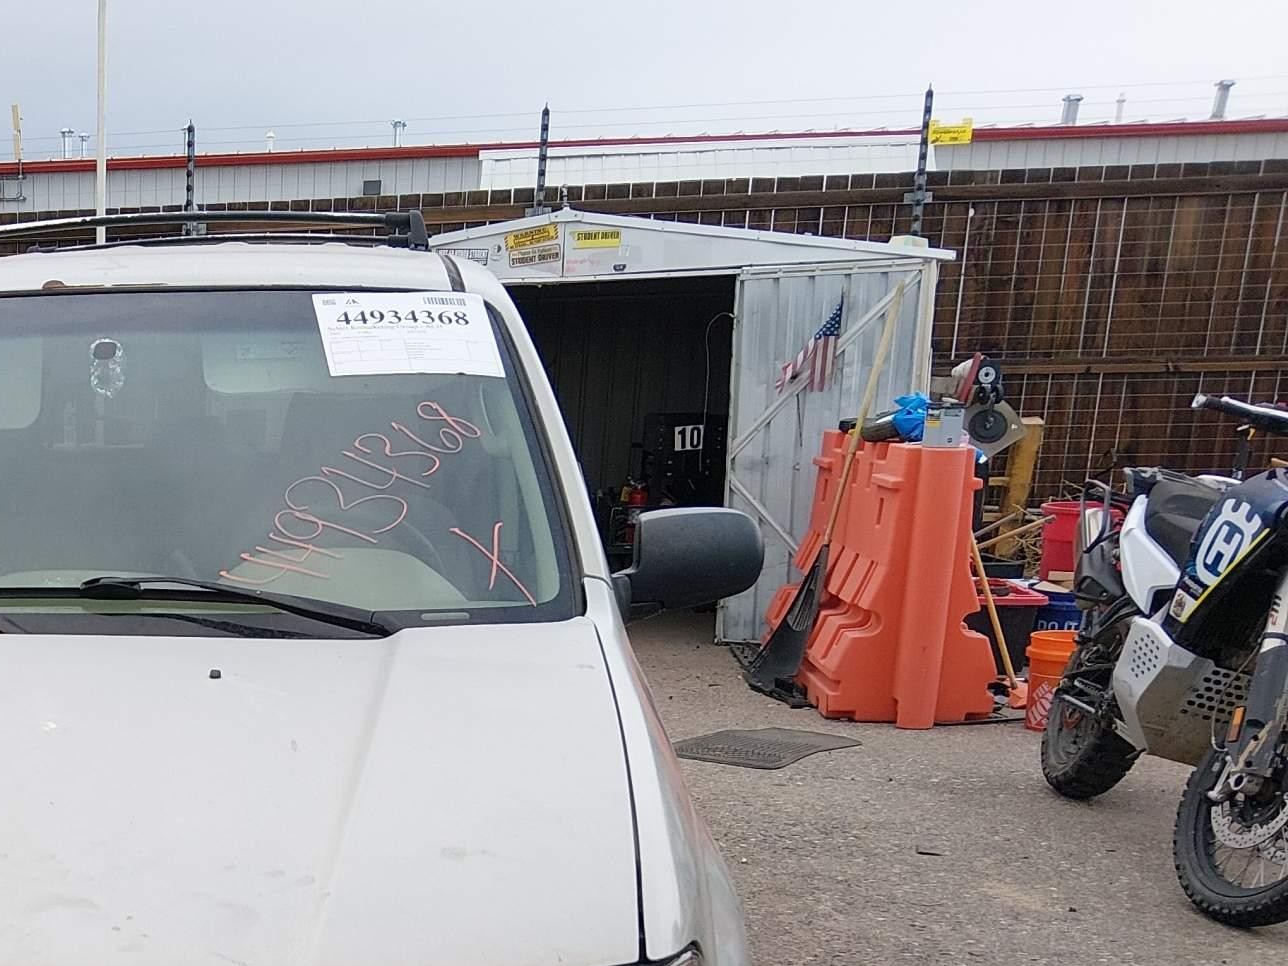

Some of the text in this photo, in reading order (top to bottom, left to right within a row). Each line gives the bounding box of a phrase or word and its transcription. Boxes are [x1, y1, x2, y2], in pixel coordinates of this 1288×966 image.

[577, 231, 620, 241] STUDENT DRIVER
[512, 252, 559, 265] STUDENT DRIVER
[336, 309, 470, 326] 44934368
[678, 426, 702, 450] 10
[219, 401, 481, 585] 44934368
